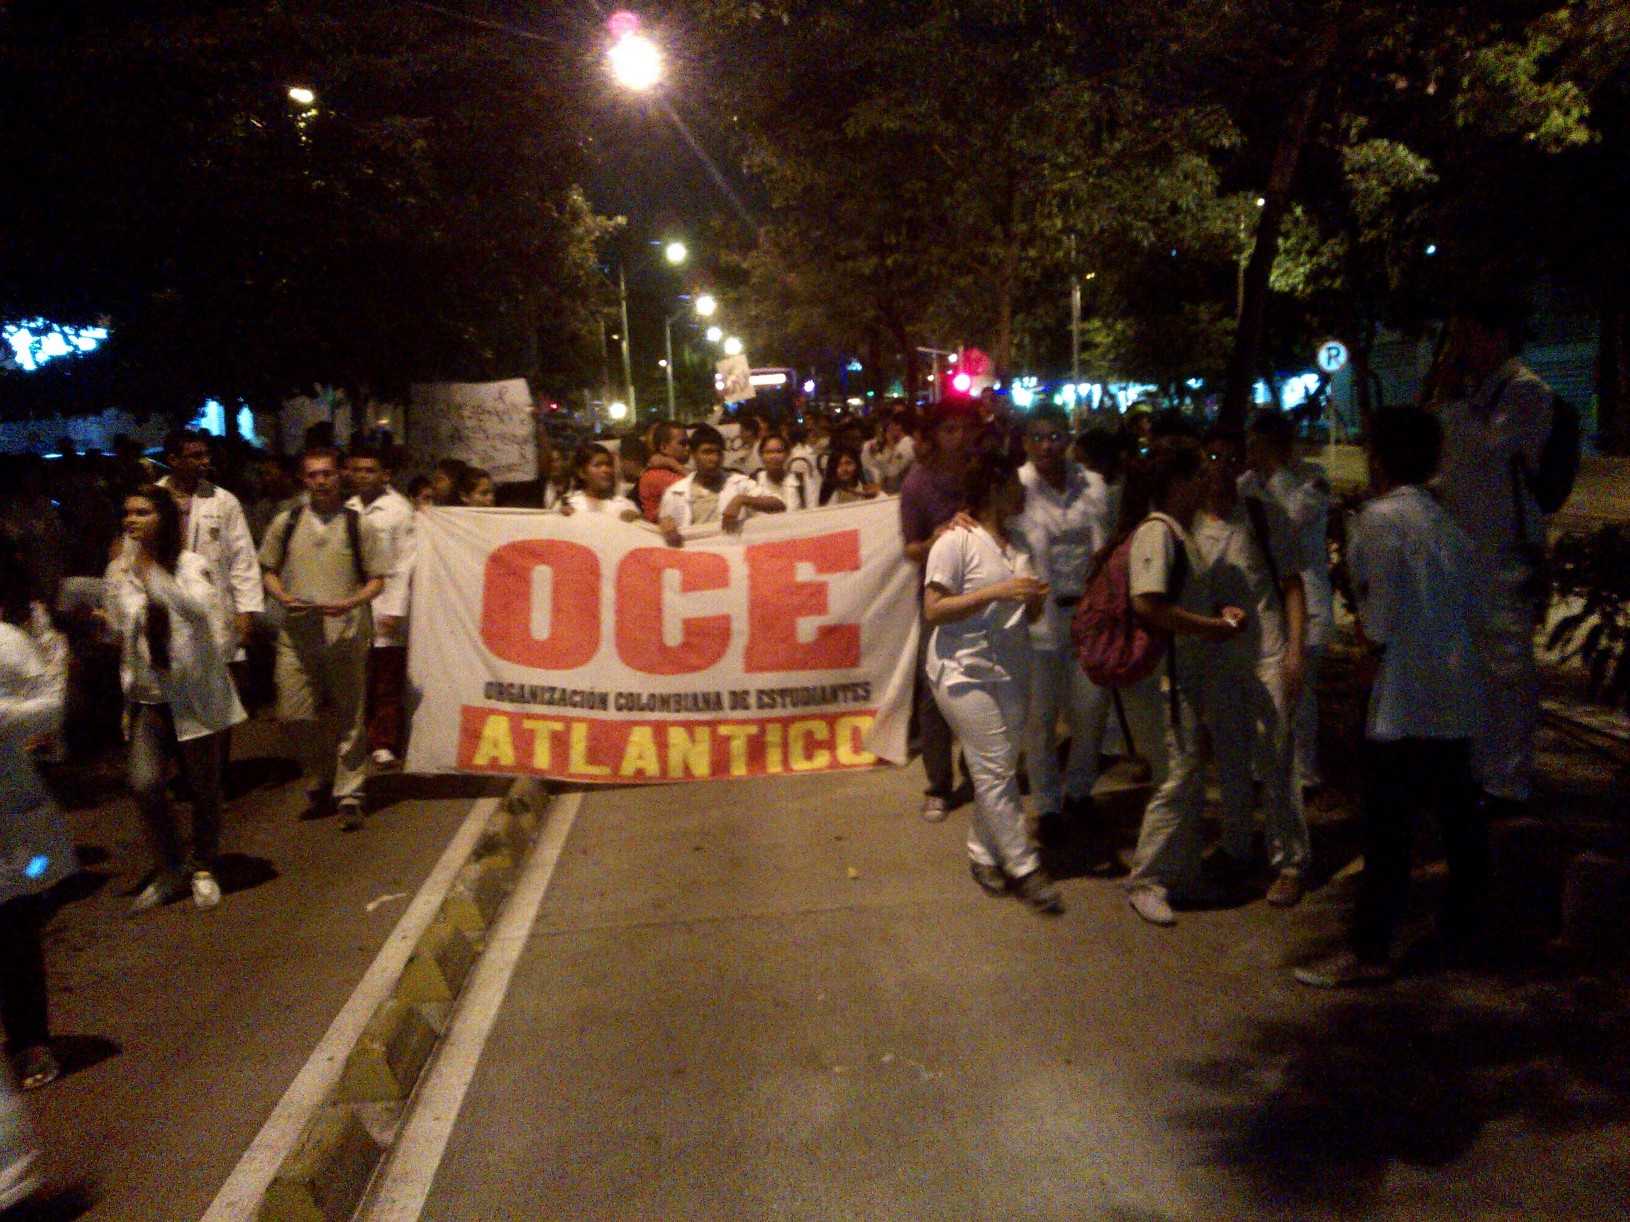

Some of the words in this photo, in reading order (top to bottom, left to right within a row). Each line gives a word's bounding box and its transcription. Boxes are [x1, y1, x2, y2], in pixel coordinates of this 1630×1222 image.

[1327, 346, 1340, 366] P
[479, 529, 861, 675] OCE
[615, 691, 723, 713] COLOMBIANA
[729, 690, 750, 710] DE
[756, 681, 871, 710] ESTUDIANTES
[473, 714, 878, 778] ATLANTICO
